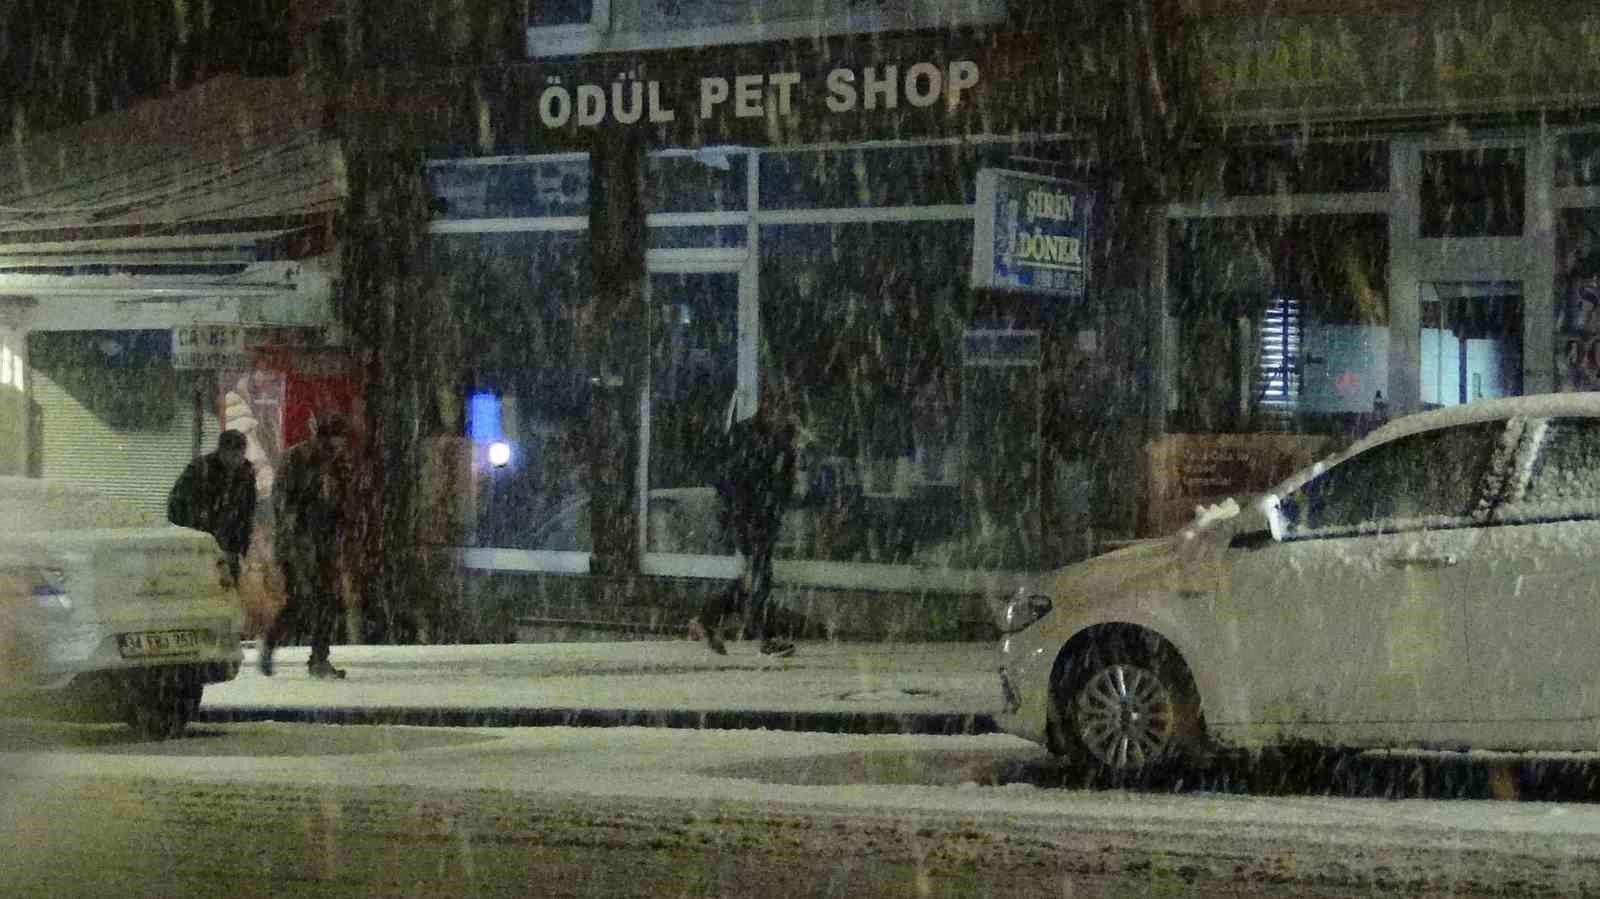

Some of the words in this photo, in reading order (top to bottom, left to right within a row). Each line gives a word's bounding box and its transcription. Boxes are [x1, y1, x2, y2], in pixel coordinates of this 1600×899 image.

[538, 73, 675, 129] ÖDÜL
[701, 72, 802, 120] PET
[825, 60, 980, 113] SHOP
[1015, 227, 1081, 264] DÖNER
